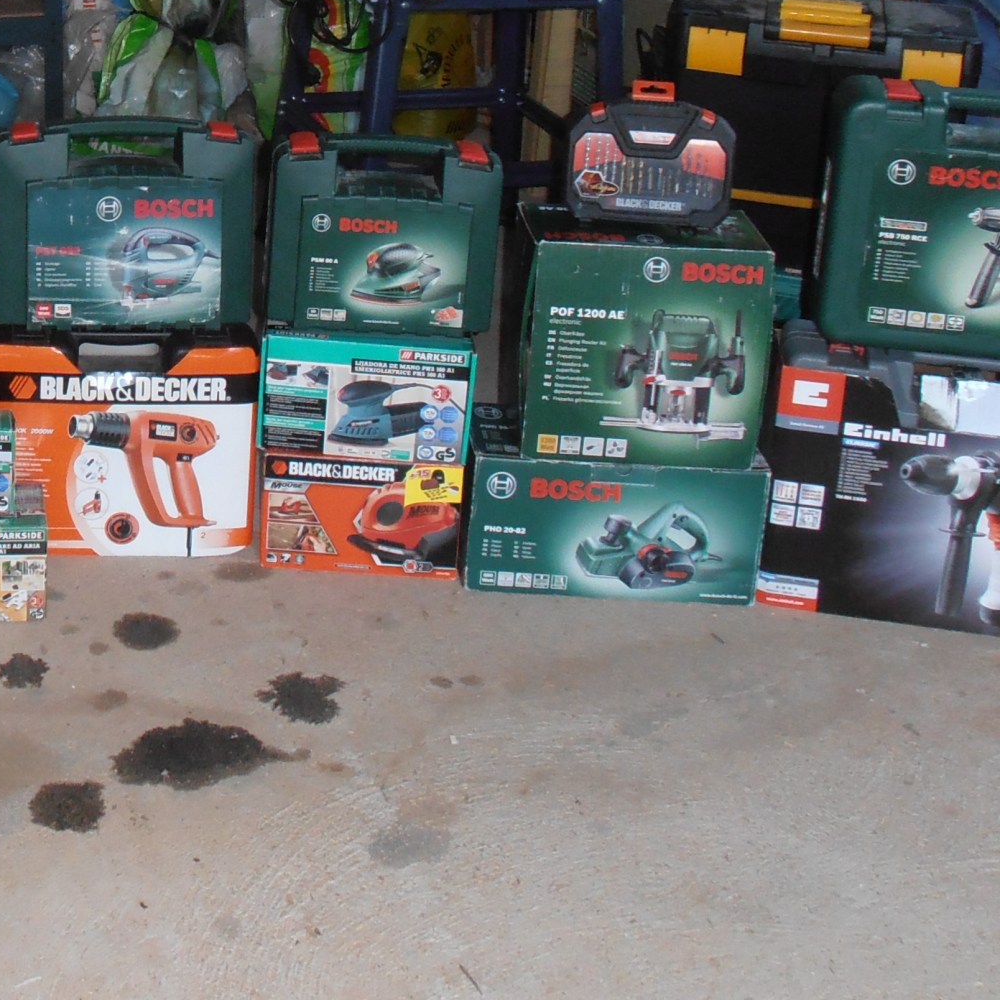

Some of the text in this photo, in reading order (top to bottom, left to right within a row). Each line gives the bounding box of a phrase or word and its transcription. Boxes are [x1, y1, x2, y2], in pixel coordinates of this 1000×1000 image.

[928, 166, 1000, 190] BOSC
[134, 198, 215, 219] BOSCH
[616, 197, 682, 212] BLACK&DECKER
[339, 217, 398, 234] BOSCH
[896, 233, 910, 241] 750
[682, 262, 765, 285] BOSCH
[550, 307, 625, 320] POF 1200 AE
[414, 352, 464, 363] PARKSIDE
[40, 374, 228, 401] BLACK&DECKER
[434, 389, 441, 399] 3
[843, 422, 946, 447] Einhell
[435, 448, 455, 460] GS
[288, 461, 396, 482] BLACK&DECKER
[530, 477, 623, 502] BOSCH
